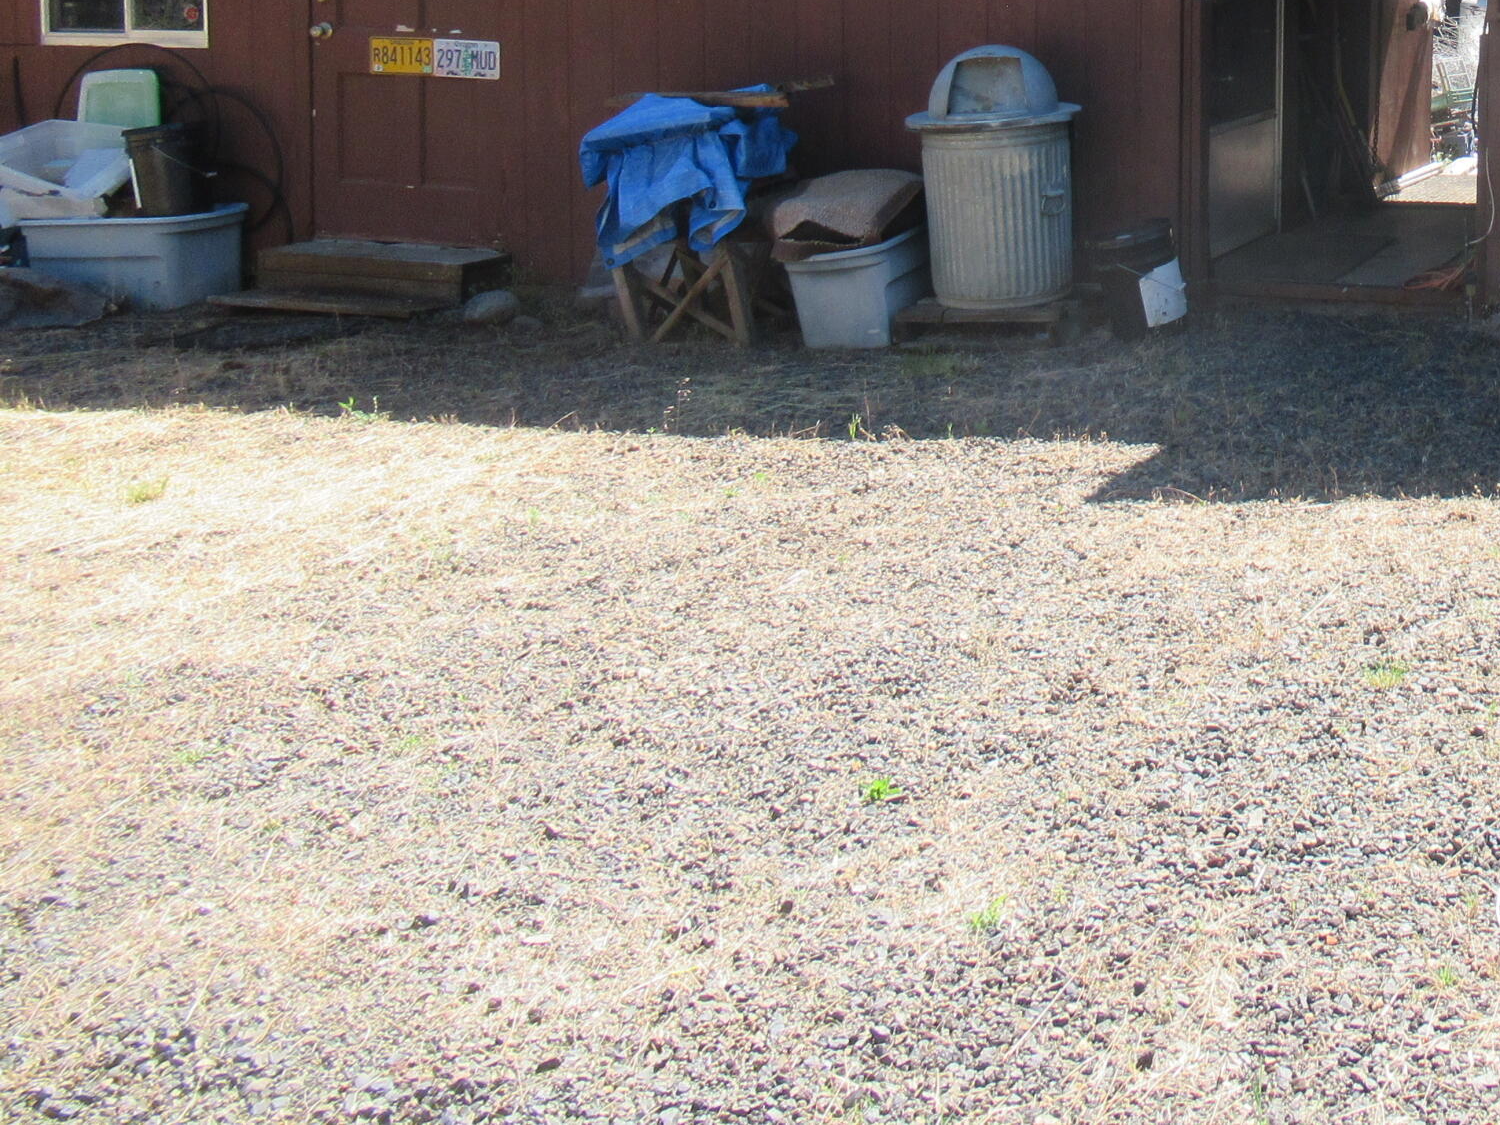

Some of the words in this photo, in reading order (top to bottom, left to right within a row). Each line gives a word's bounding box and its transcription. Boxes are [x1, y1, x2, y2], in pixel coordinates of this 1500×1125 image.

[373, 46, 431, 66] R841143
[437, 48, 462, 68] 297
[471, 50, 497, 70] MUD
